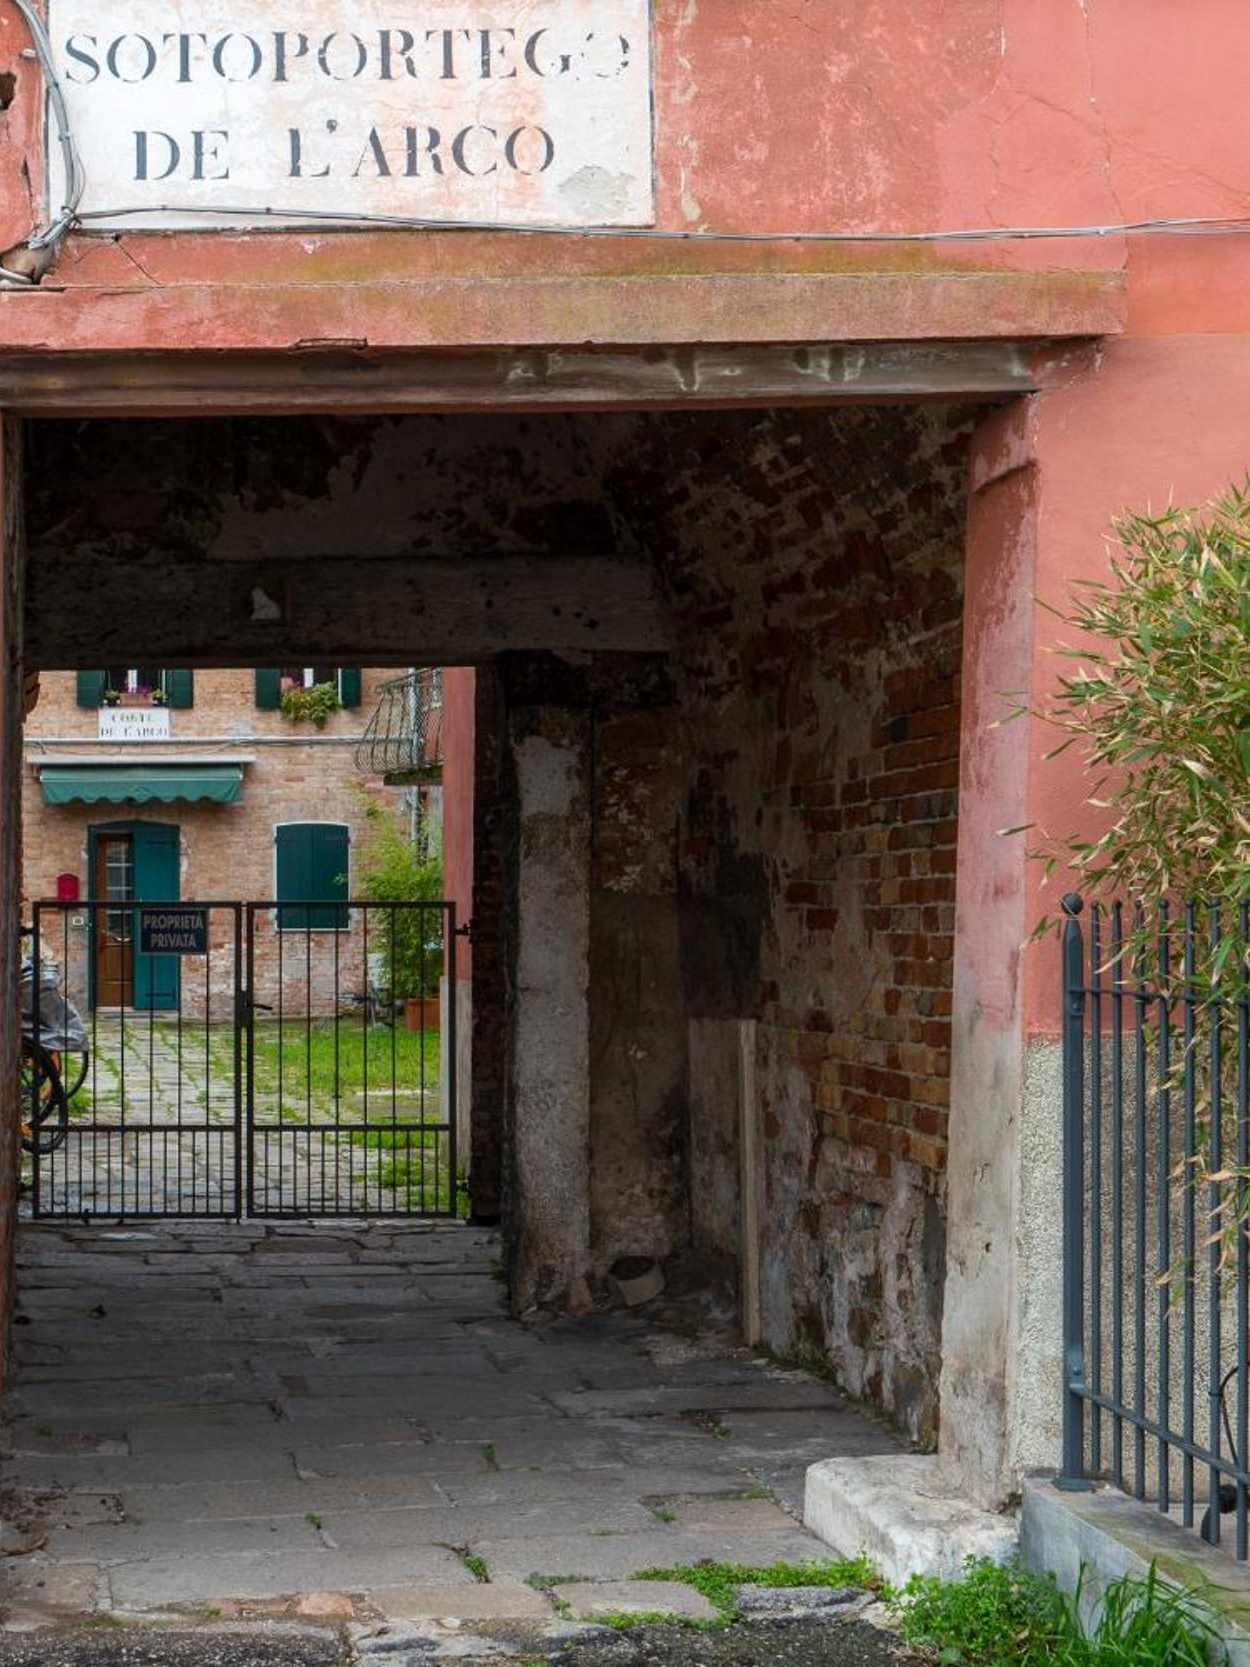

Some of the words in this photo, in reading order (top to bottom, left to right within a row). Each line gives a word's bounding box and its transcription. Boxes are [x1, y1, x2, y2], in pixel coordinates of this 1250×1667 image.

[132, 130, 230, 181] DE
[286, 119, 555, 178] L'ARCO
[151, 933, 197, 947] PRIVATA
